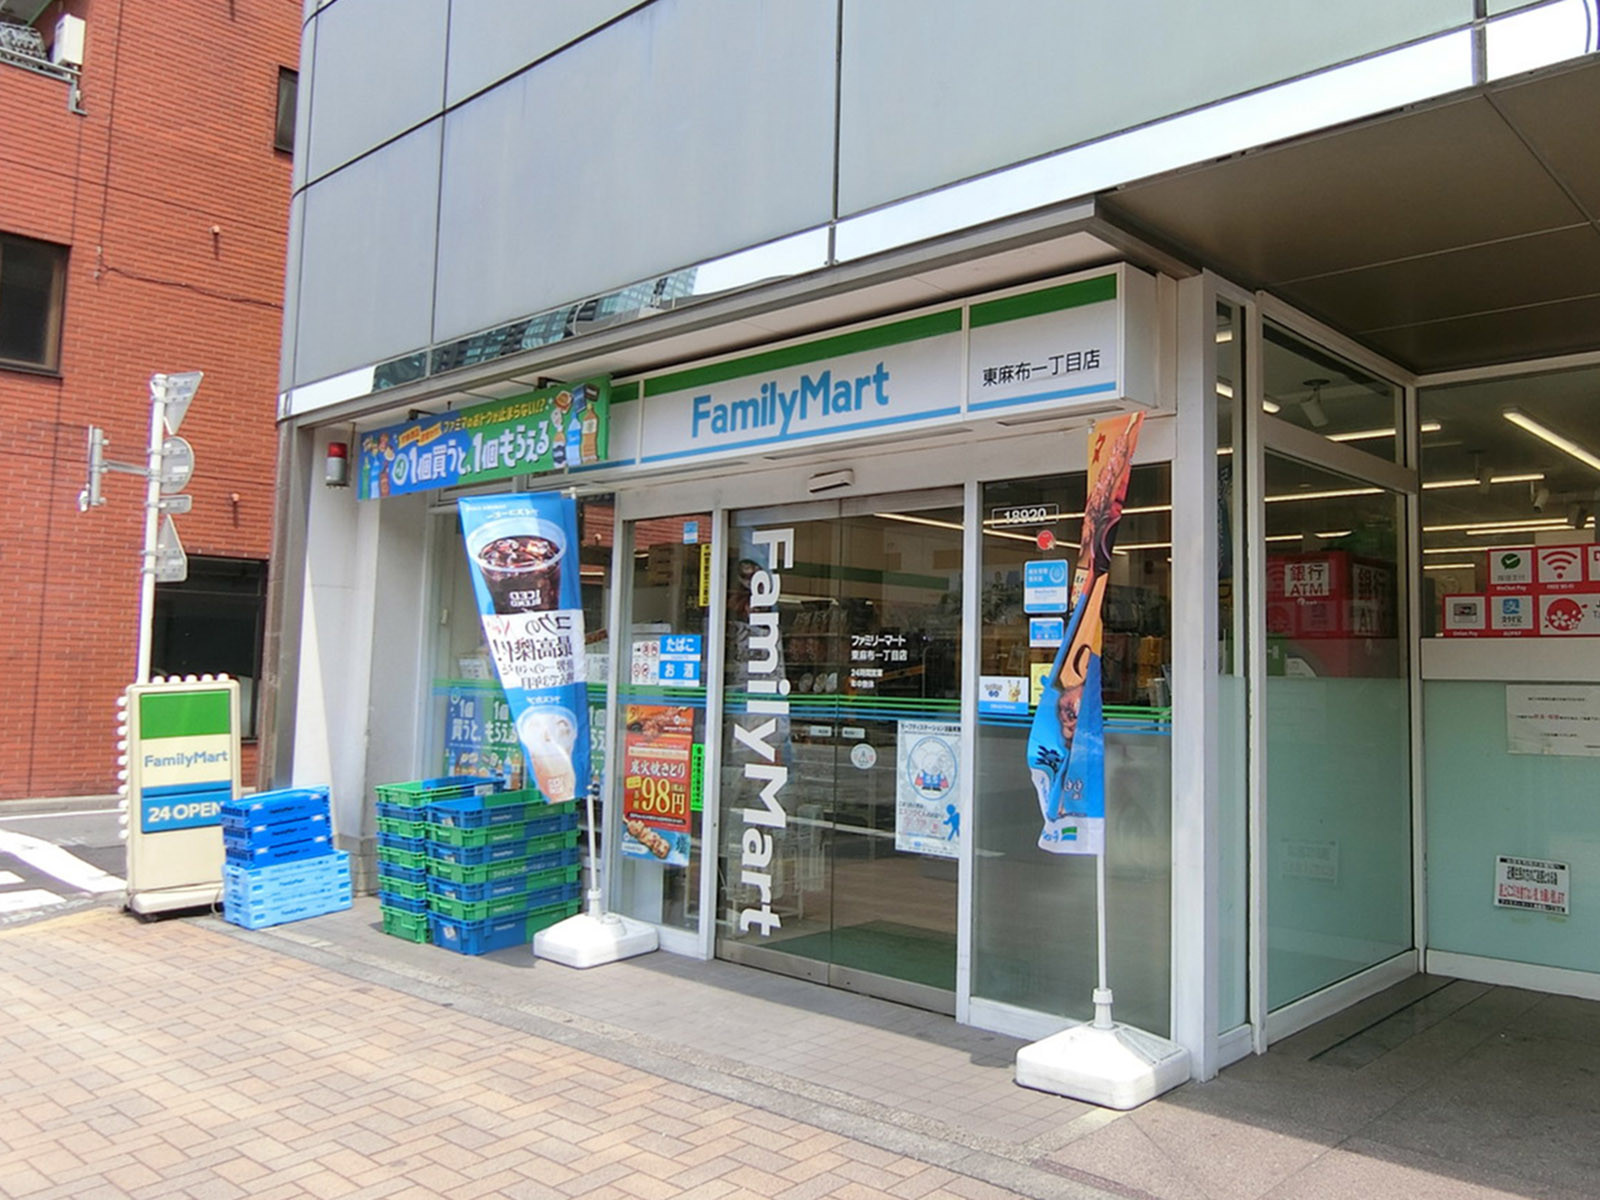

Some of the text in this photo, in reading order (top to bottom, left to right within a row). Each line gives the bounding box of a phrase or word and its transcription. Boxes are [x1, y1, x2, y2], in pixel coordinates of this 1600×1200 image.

[982, 349, 1101, 387] 東麻布一丁目店
[692, 362, 890, 438] FamilyMart
[1003, 507, 1048, 525] 18920
[1290, 583, 1324, 595] ATM
[665, 637, 695, 652] たばこ
[850, 633, 907, 648] ファミリーマート
[733, 527, 796, 938] FamilyMart
[143, 749, 229, 769] FamilyMart
